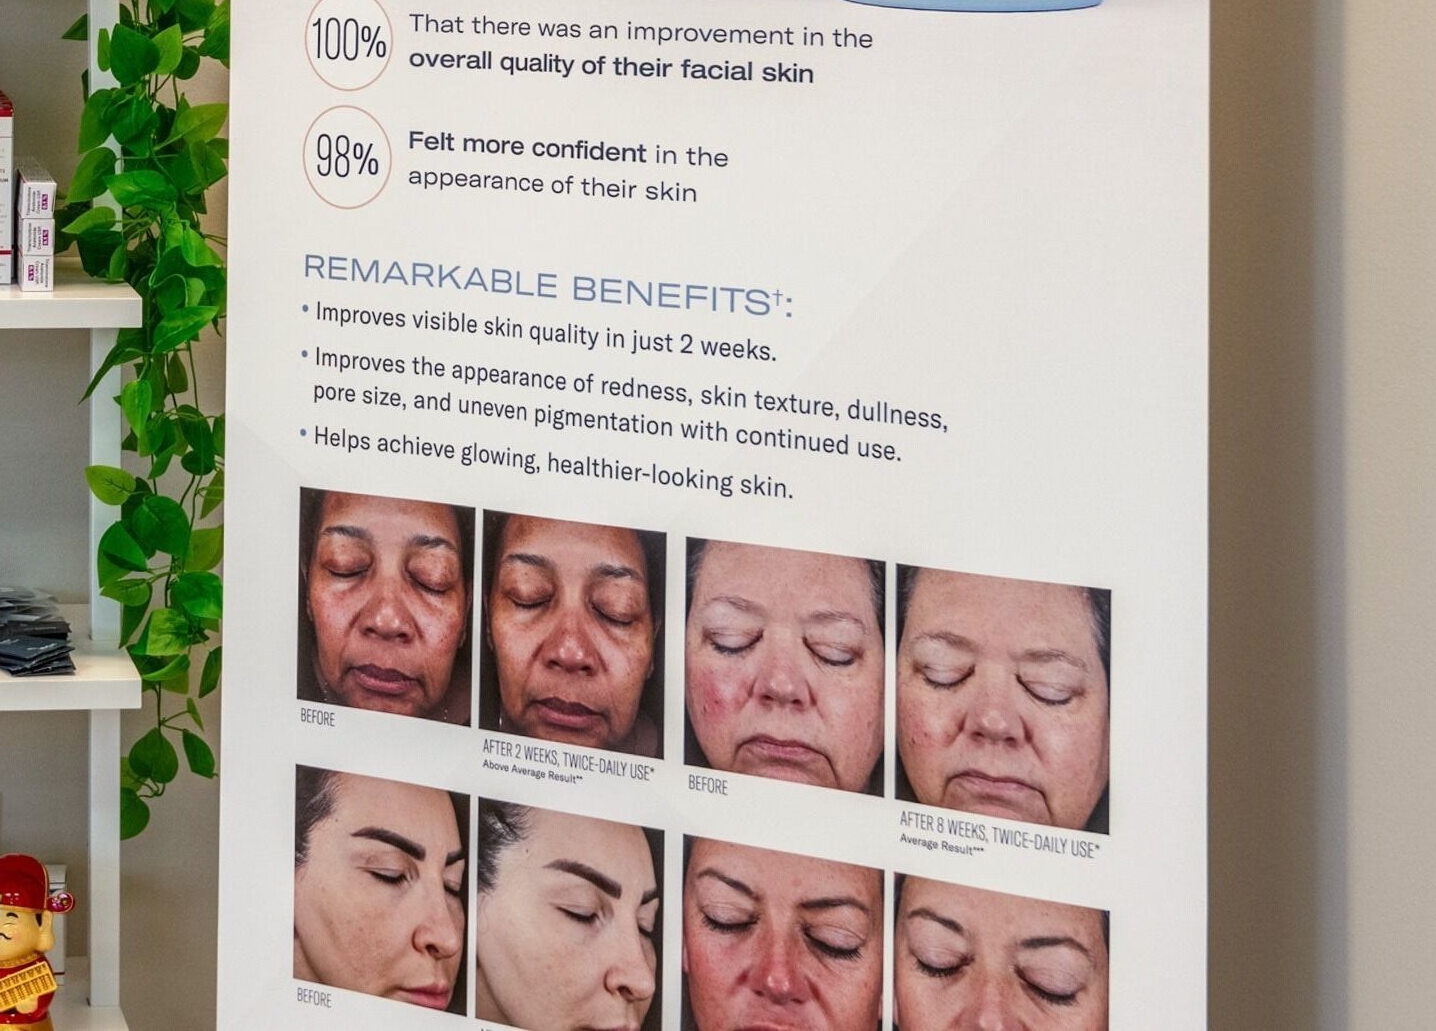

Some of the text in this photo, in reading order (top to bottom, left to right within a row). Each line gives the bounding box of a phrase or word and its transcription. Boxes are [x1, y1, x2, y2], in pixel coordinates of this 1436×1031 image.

[313, 18, 386, 61] 100%
[409, 14, 872, 48] That there was an improvement in the
[410, 51, 813, 83] overall quality of their facial skin
[317, 134, 378, 177] 98%
[410, 131, 728, 167] Felt more confident in the
[409, 171, 696, 202] appearance of their skin
[305, 254, 557, 298] REMARKABLE
[317, 301, 776, 361] Improves visible skin quality in just 2 weeks.
[317, 347, 947, 433] Improves the appearance of redness, skin texture, dullness,
[314, 385, 901, 461] pore size, and uneven pigmentation with continued use.
[315, 426, 792, 498] Helps achieve glowing, healthier-looking skin.
[301, 708, 335, 727] BEFORE
[483, 739, 512, 756] AFTER
[515, 744, 521, 759] 2
[524, 746, 559, 767] WEEKS,
[564, 753, 626, 776] TWICE-DAILY
[689, 774, 727, 795] BEFORE
[900, 810, 933, 831] AFTER
[937, 817, 944, 833] 8
[948, 819, 988, 842] WEEKS,
[992, 827, 1067, 853] TWICE-DAILY
[297, 988, 331, 1008] BEFORE
